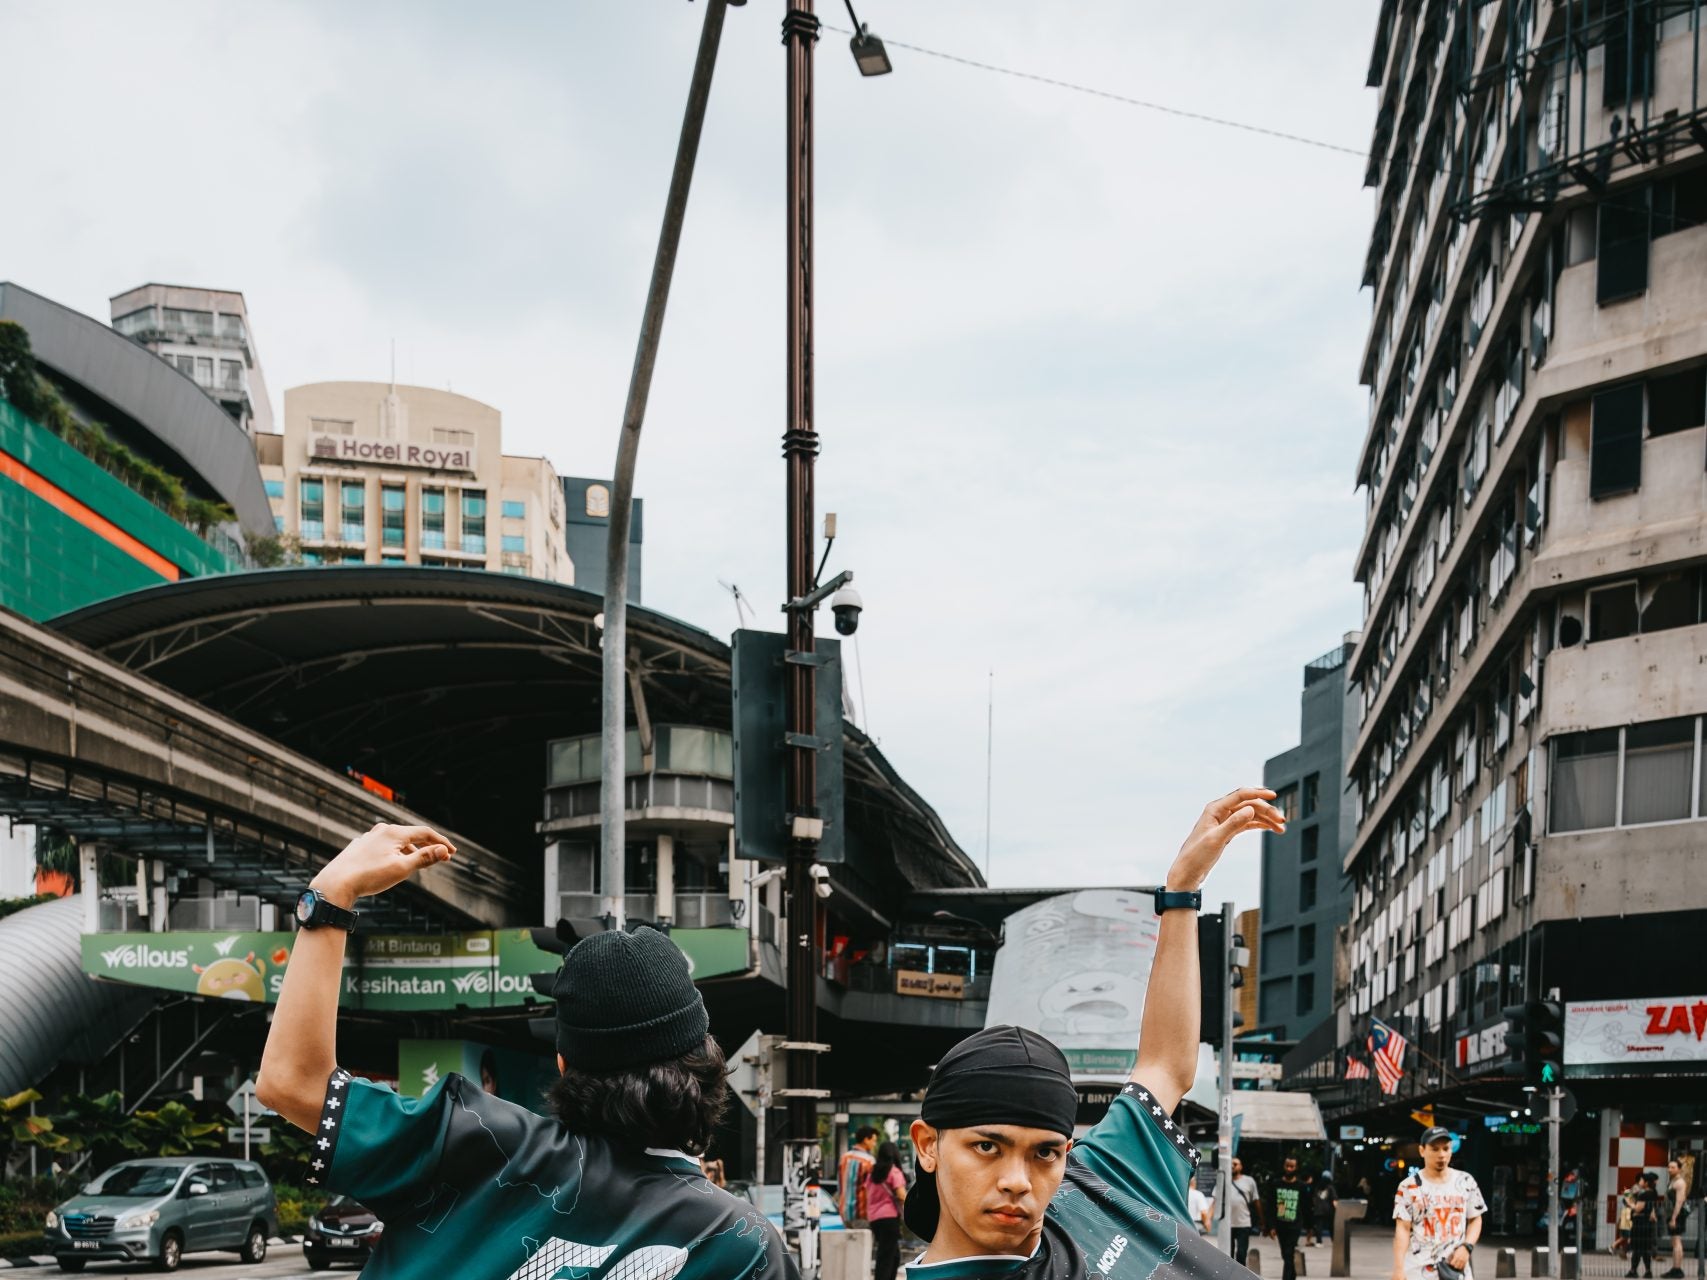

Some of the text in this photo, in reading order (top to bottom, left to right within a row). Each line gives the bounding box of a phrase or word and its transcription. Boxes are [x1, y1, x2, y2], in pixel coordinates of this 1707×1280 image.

[342, 440, 470, 468] Hotel Royal
[101, 944, 188, 969] Wellous
[389, 939, 441, 955] Bintang
[346, 974, 446, 995] Kesihatan
[1087, 1093, 1114, 1104] BINT
[1096, 1234, 1128, 1274] MCPLUS
